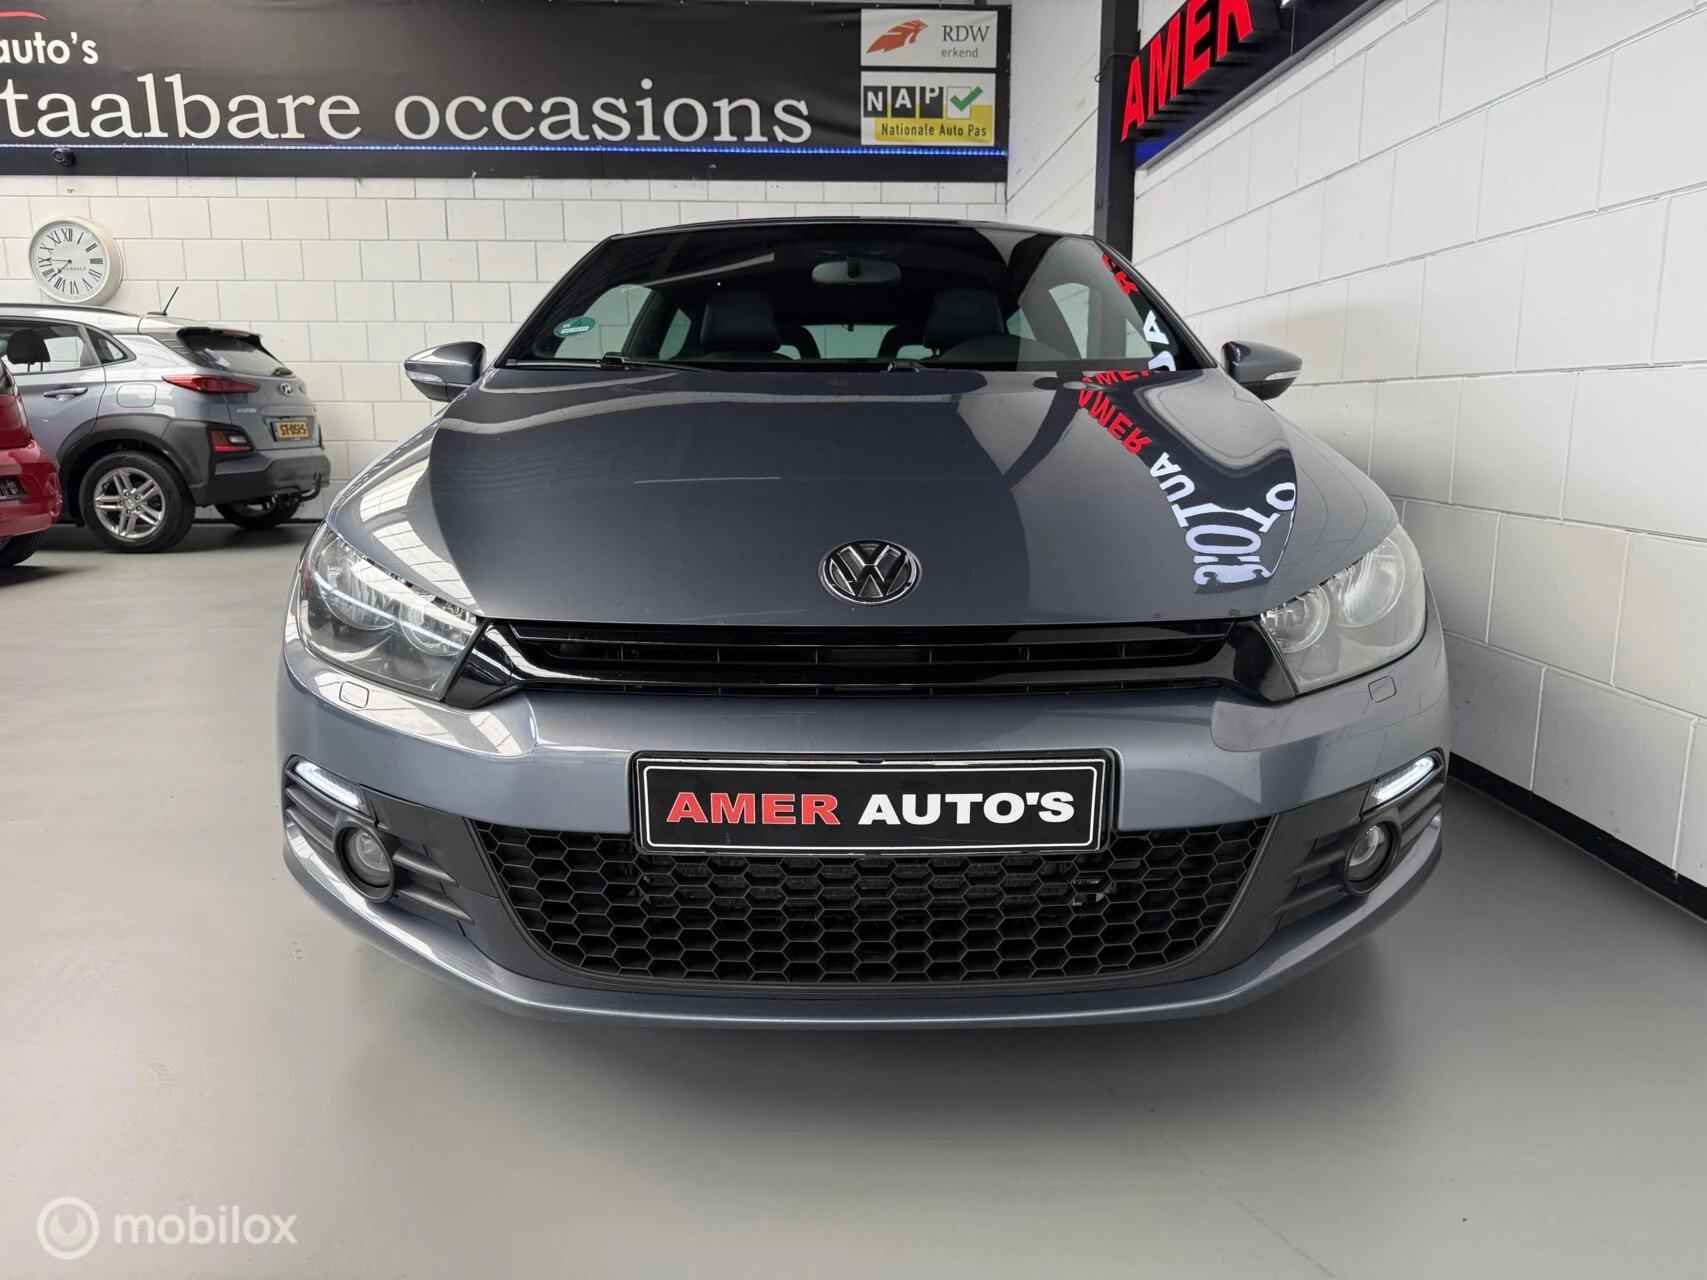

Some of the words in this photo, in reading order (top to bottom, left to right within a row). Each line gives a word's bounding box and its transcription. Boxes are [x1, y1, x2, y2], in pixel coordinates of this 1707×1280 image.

[941, 25, 991, 42] RDW
[941, 48, 978, 58] erkend
[866, 86, 940, 112] NAP
[394, 78, 812, 143] occasions
[881, 122, 935, 137] Nationale
[939, 124, 964, 137] Auto
[968, 124, 987, 137] Pas
[666, 792, 841, 825] AMER
[857, 791, 1075, 826] AUTO'S
